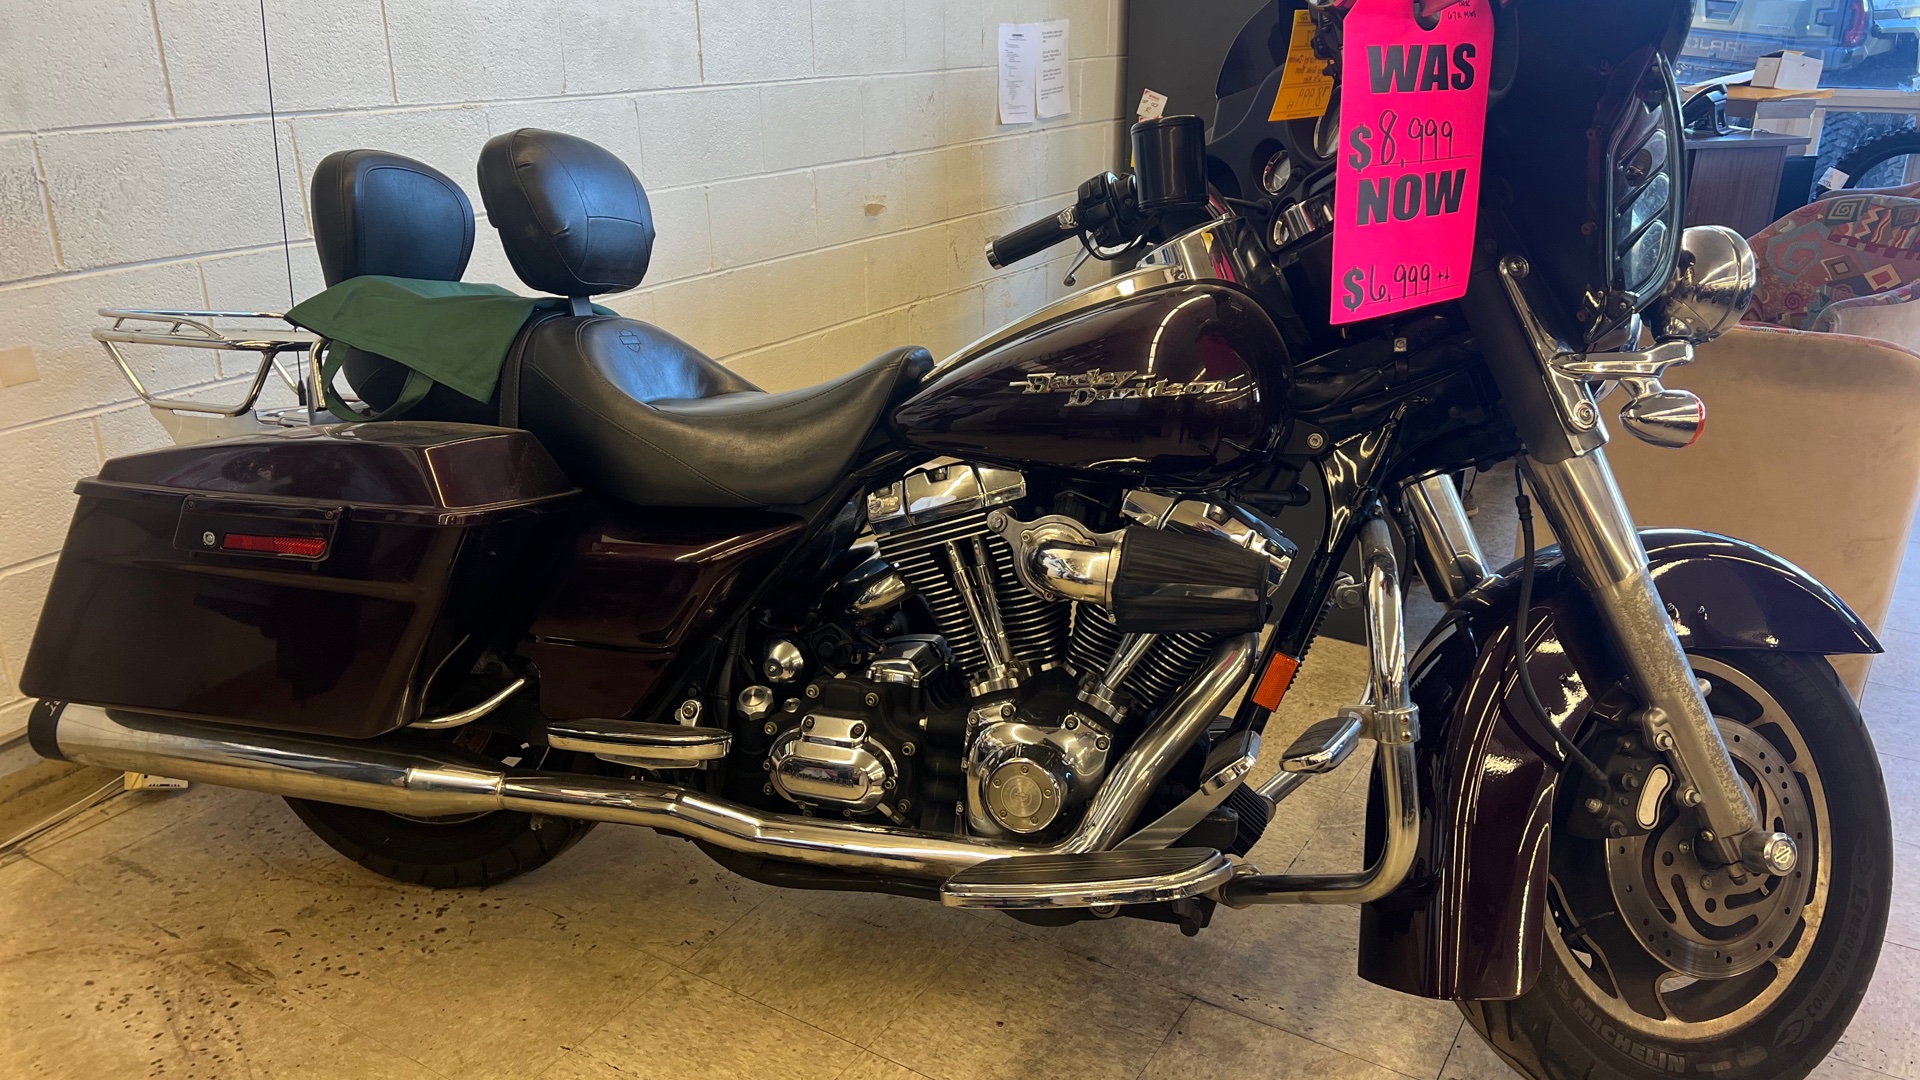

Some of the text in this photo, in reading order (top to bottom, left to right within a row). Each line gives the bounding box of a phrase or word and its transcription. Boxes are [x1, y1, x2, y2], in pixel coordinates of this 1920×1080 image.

[1367, 43, 1476, 94] WAS
[1357, 168, 1467, 226] NOW
[1572, 997, 1686, 1073] MICHELIN
